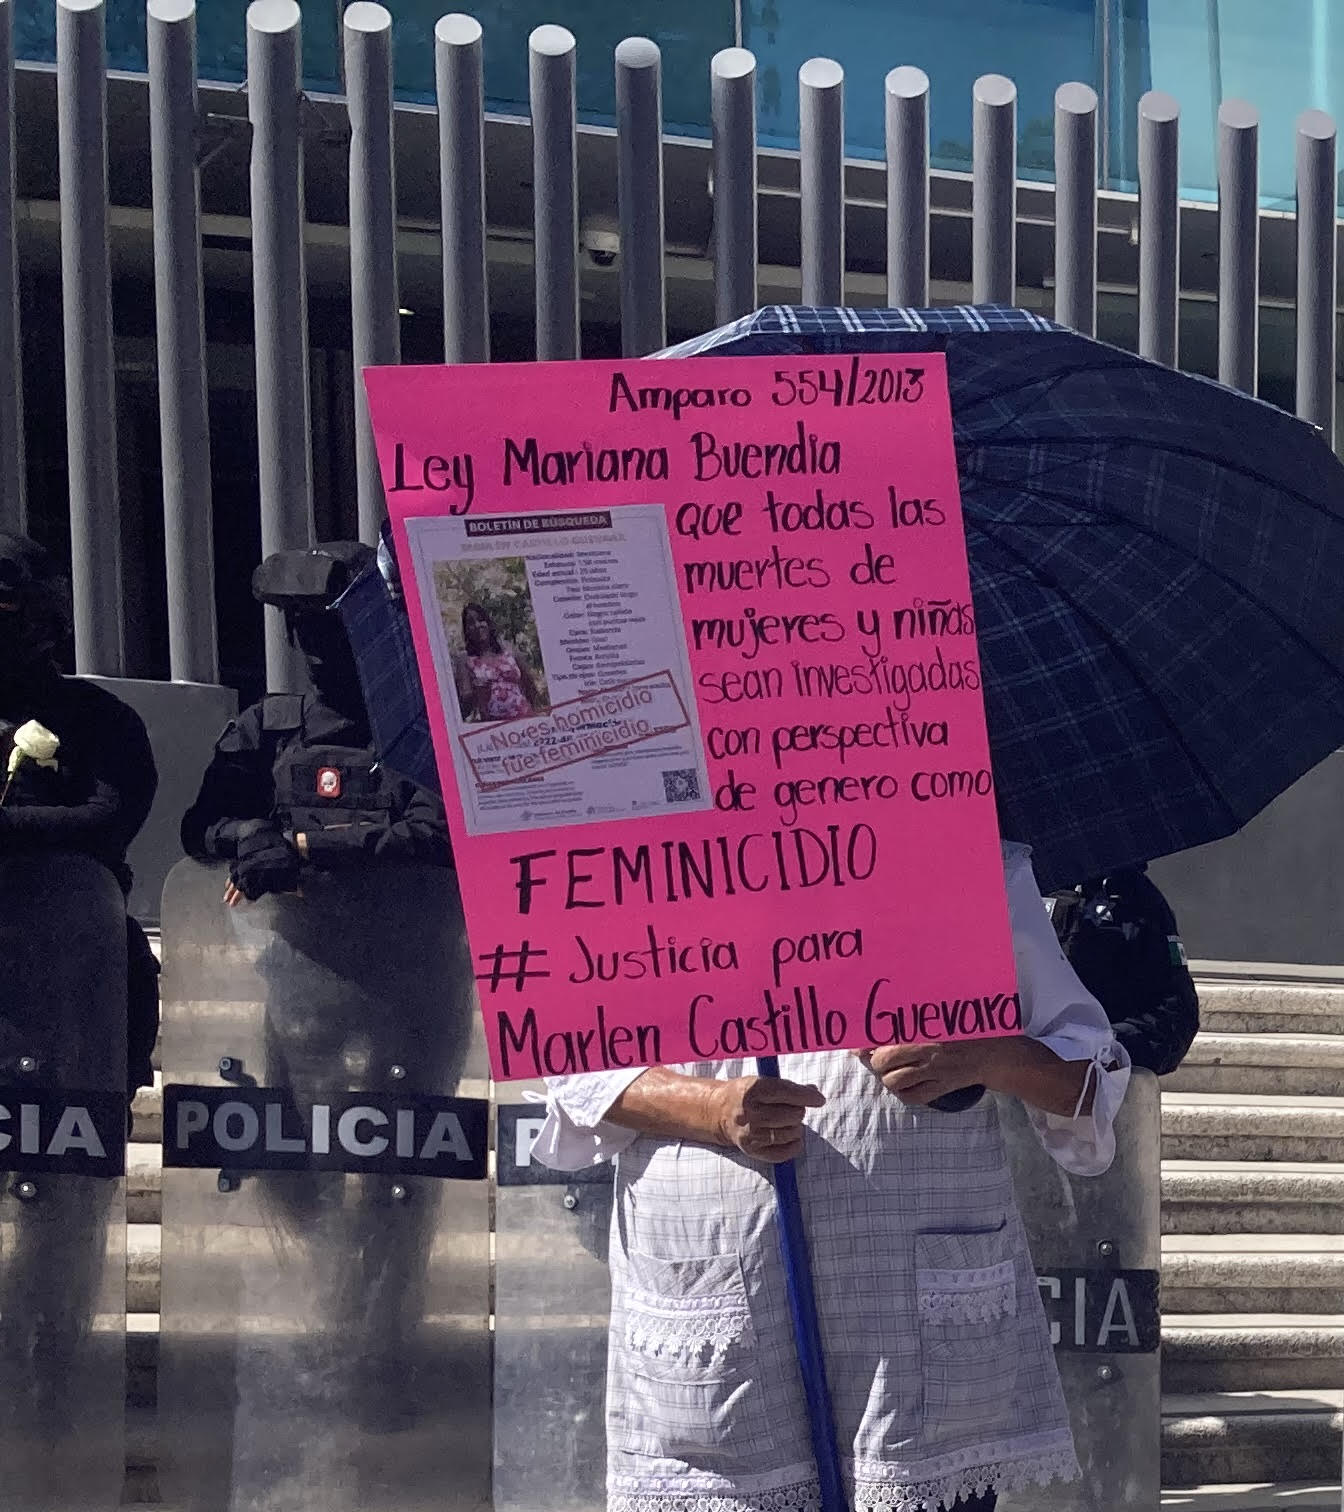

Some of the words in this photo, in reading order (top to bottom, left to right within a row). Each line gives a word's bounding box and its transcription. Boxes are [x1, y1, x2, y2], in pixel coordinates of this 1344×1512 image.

[609, 372, 753, 418] Amparo
[772, 358, 925, 406] 554/2013
[389, 444, 474, 515] Ley
[505, 438, 669, 485] Mariana
[524, 519, 539, 529] DE
[762, 490, 874, 532] todas
[890, 486, 945, 527] las
[685, 550, 831, 594] muertes
[850, 544, 896, 585] de
[693, 608, 845, 659] mujeres
[553, 689, 653, 732] homicidio
[700, 661, 784, 702] sean
[800, 655, 979, 711] investigadas
[539, 719, 648, 764] feminicidio
[708, 728, 760, 756] con
[773, 715, 949, 768] perspectiva
[717, 769, 756, 811] de
[776, 774, 897, 825] genero
[910, 768, 992, 799] como
[511, 825, 877, 914] FEMINICIDIO
[571, 926, 740, 983] Justicia
[773, 926, 862, 985] para
[498, 1005, 661, 1076] Marlen
[689, 986, 845, 1057] Castillo
[865, 980, 1022, 1046] Guevara
[176, 1101, 474, 1161] POLICIA
